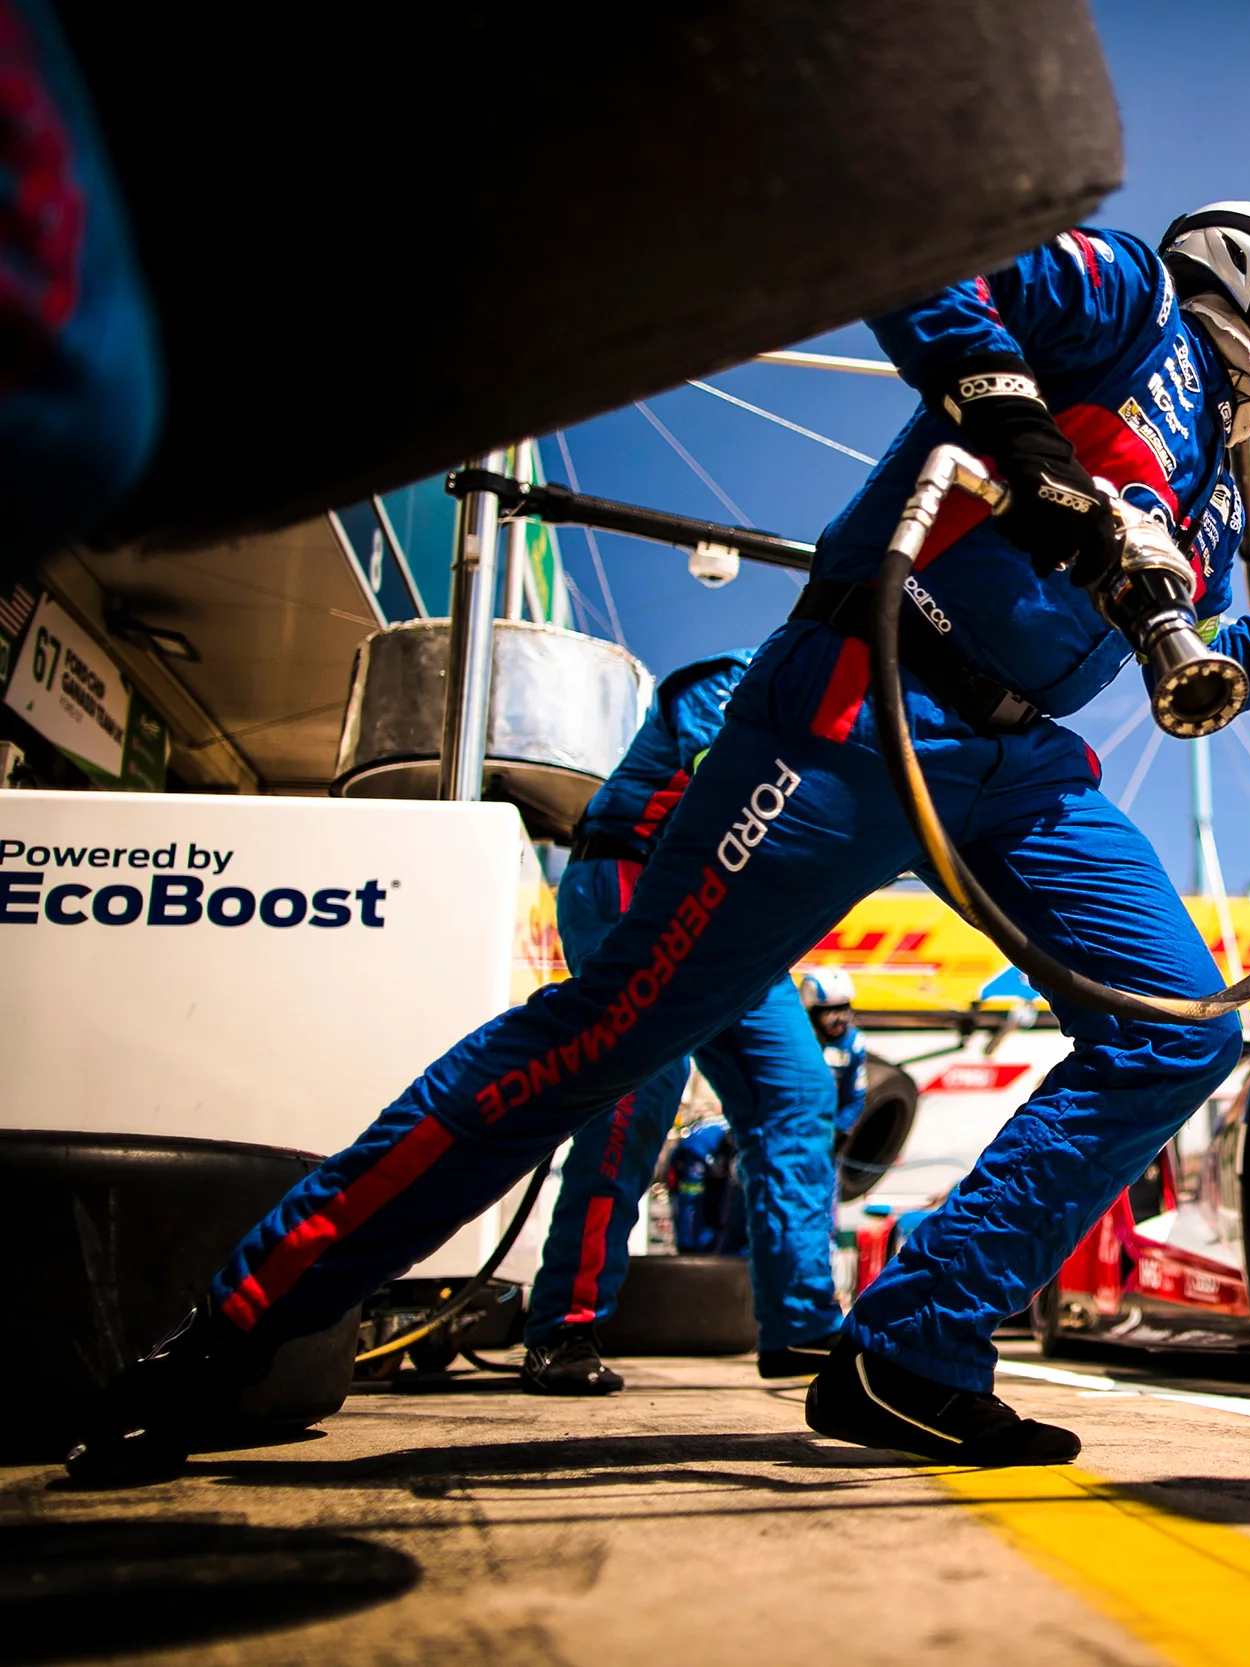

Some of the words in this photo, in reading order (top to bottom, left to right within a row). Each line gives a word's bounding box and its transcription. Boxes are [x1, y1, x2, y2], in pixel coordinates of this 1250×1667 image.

[1038, 487, 1091, 513] sparco
[904, 576, 952, 632] parco
[33, 625, 62, 692] 67
[717, 758, 801, 872] FORD
[0, 838, 177, 869] Powered
[187, 842, 235, 875] by
[475, 866, 727, 1125] PERFORMANCE
